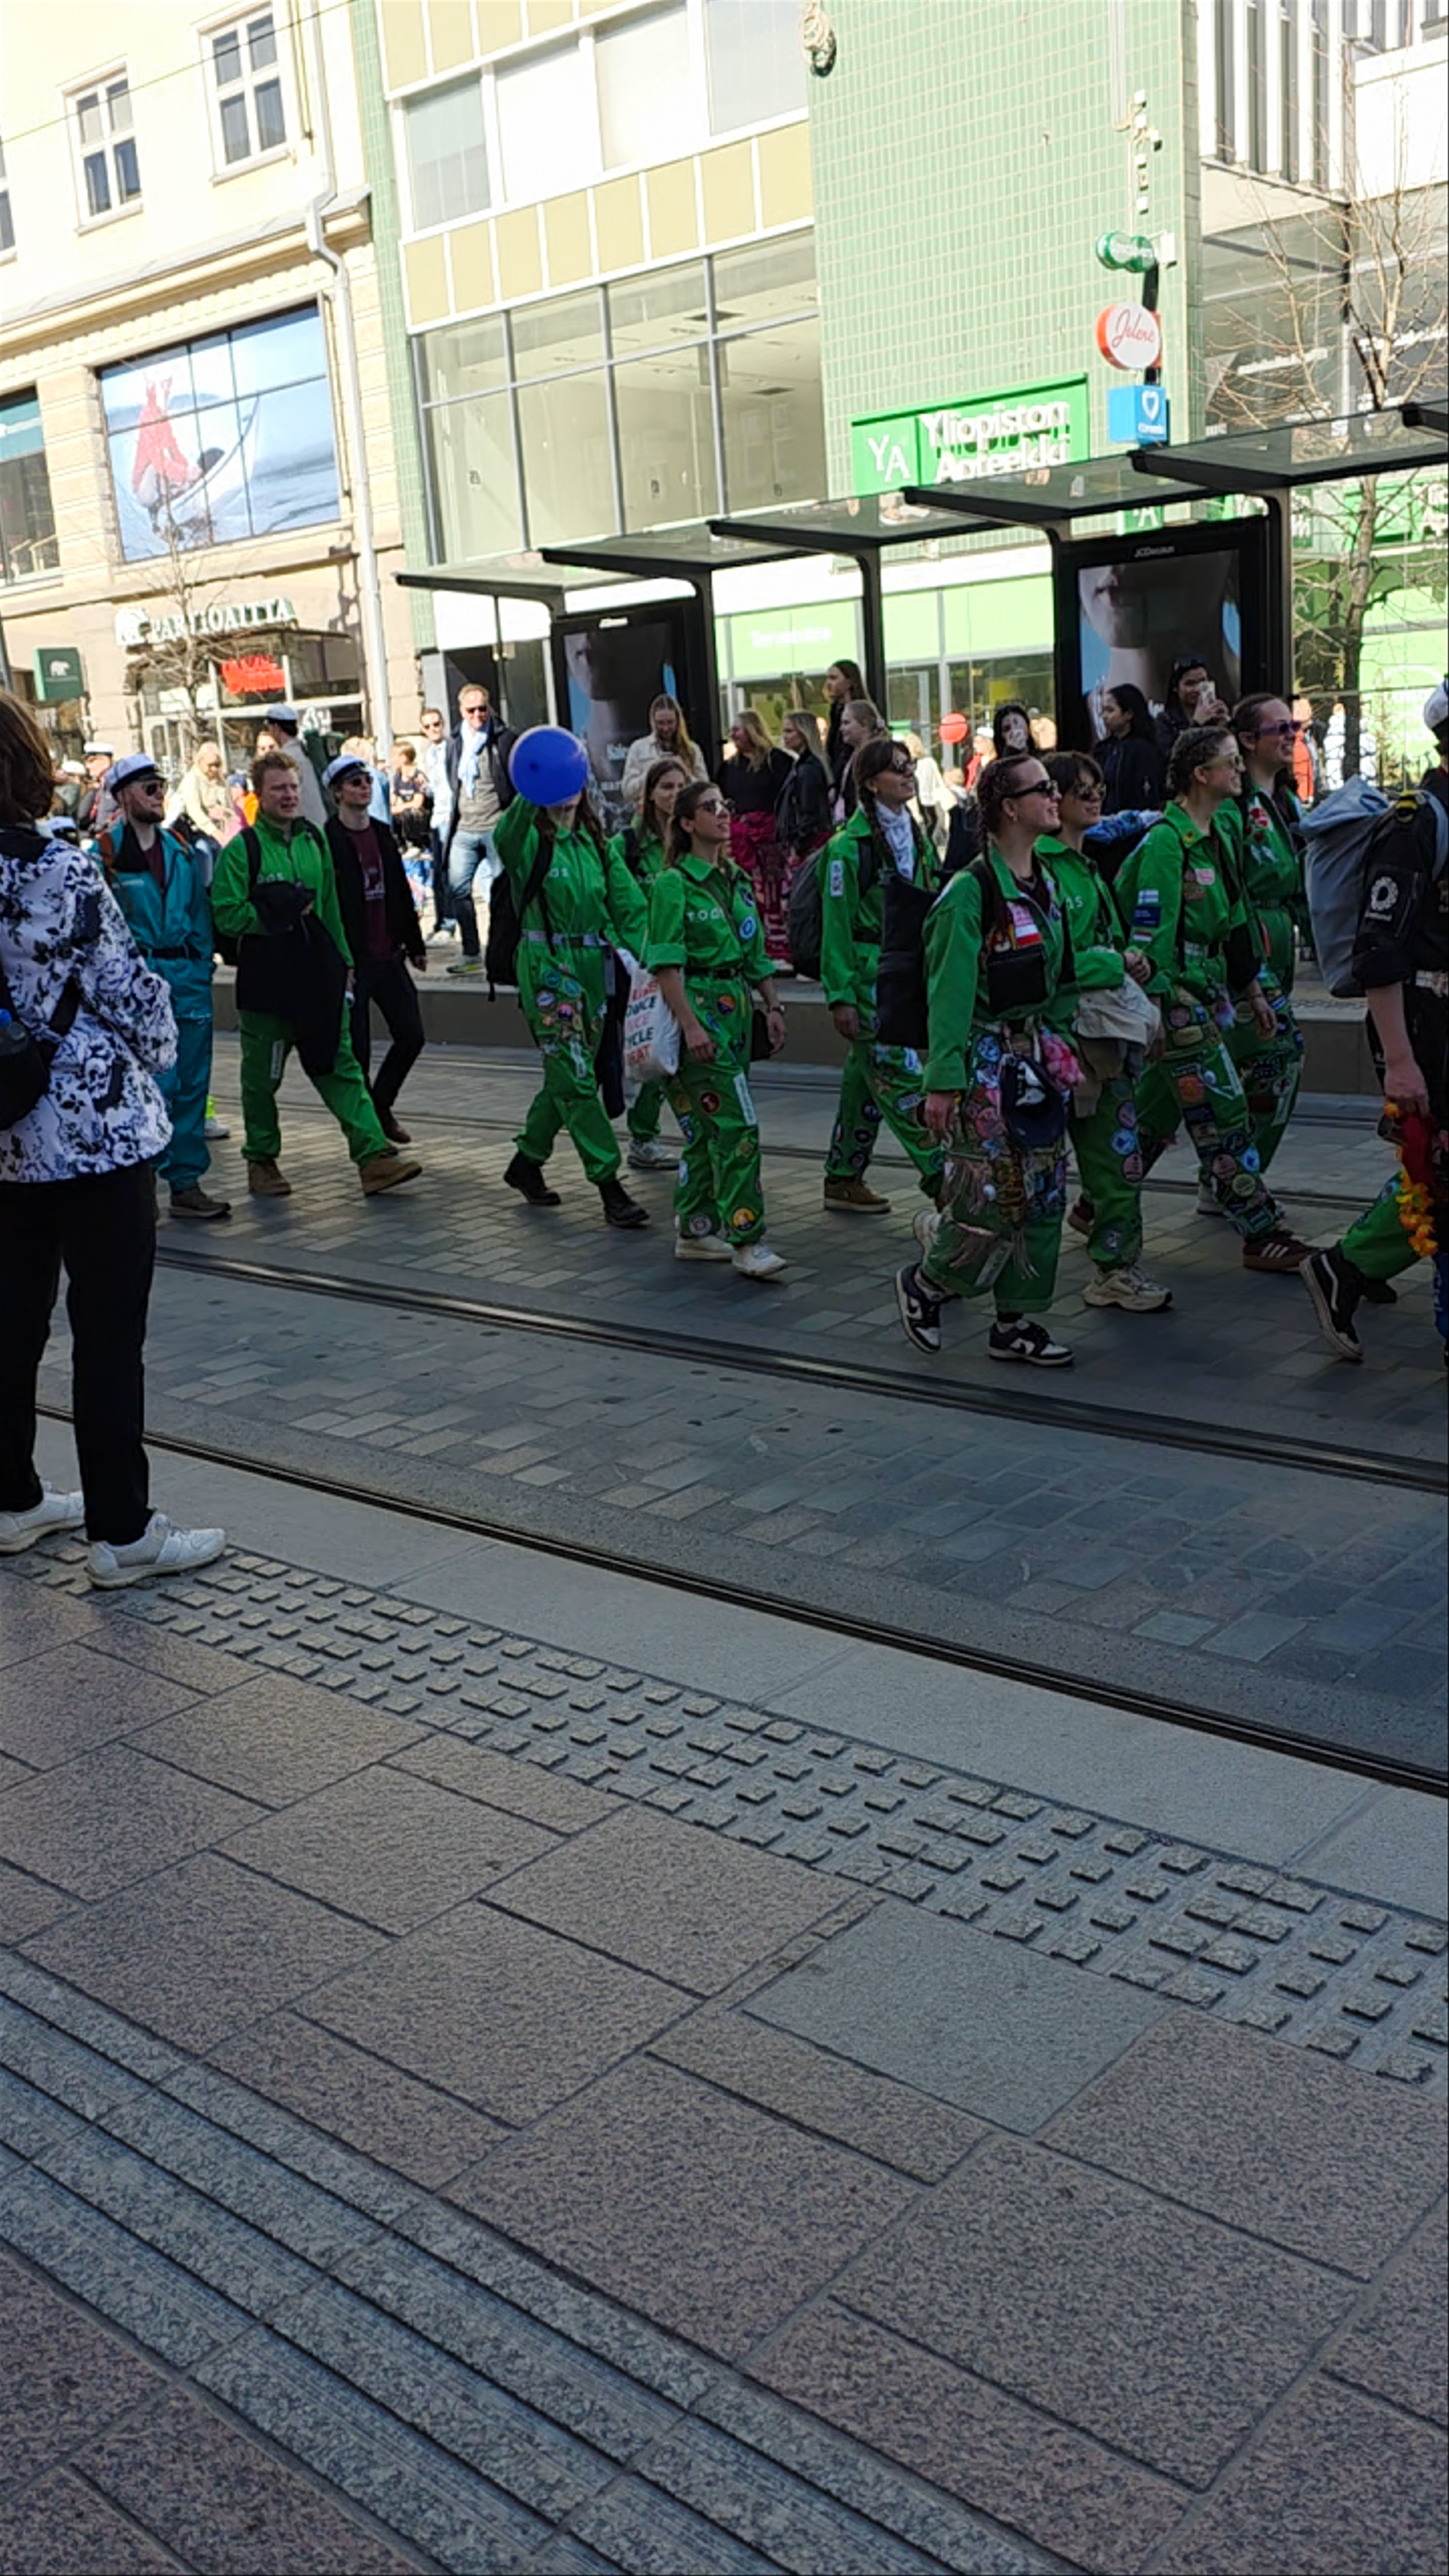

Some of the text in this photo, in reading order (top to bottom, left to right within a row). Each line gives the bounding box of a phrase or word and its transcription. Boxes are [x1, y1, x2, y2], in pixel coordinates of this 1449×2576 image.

[919, 401, 1071, 447] Yliopiston
[868, 435, 910, 483] YA
[935, 434, 1071, 484] Apteekki
